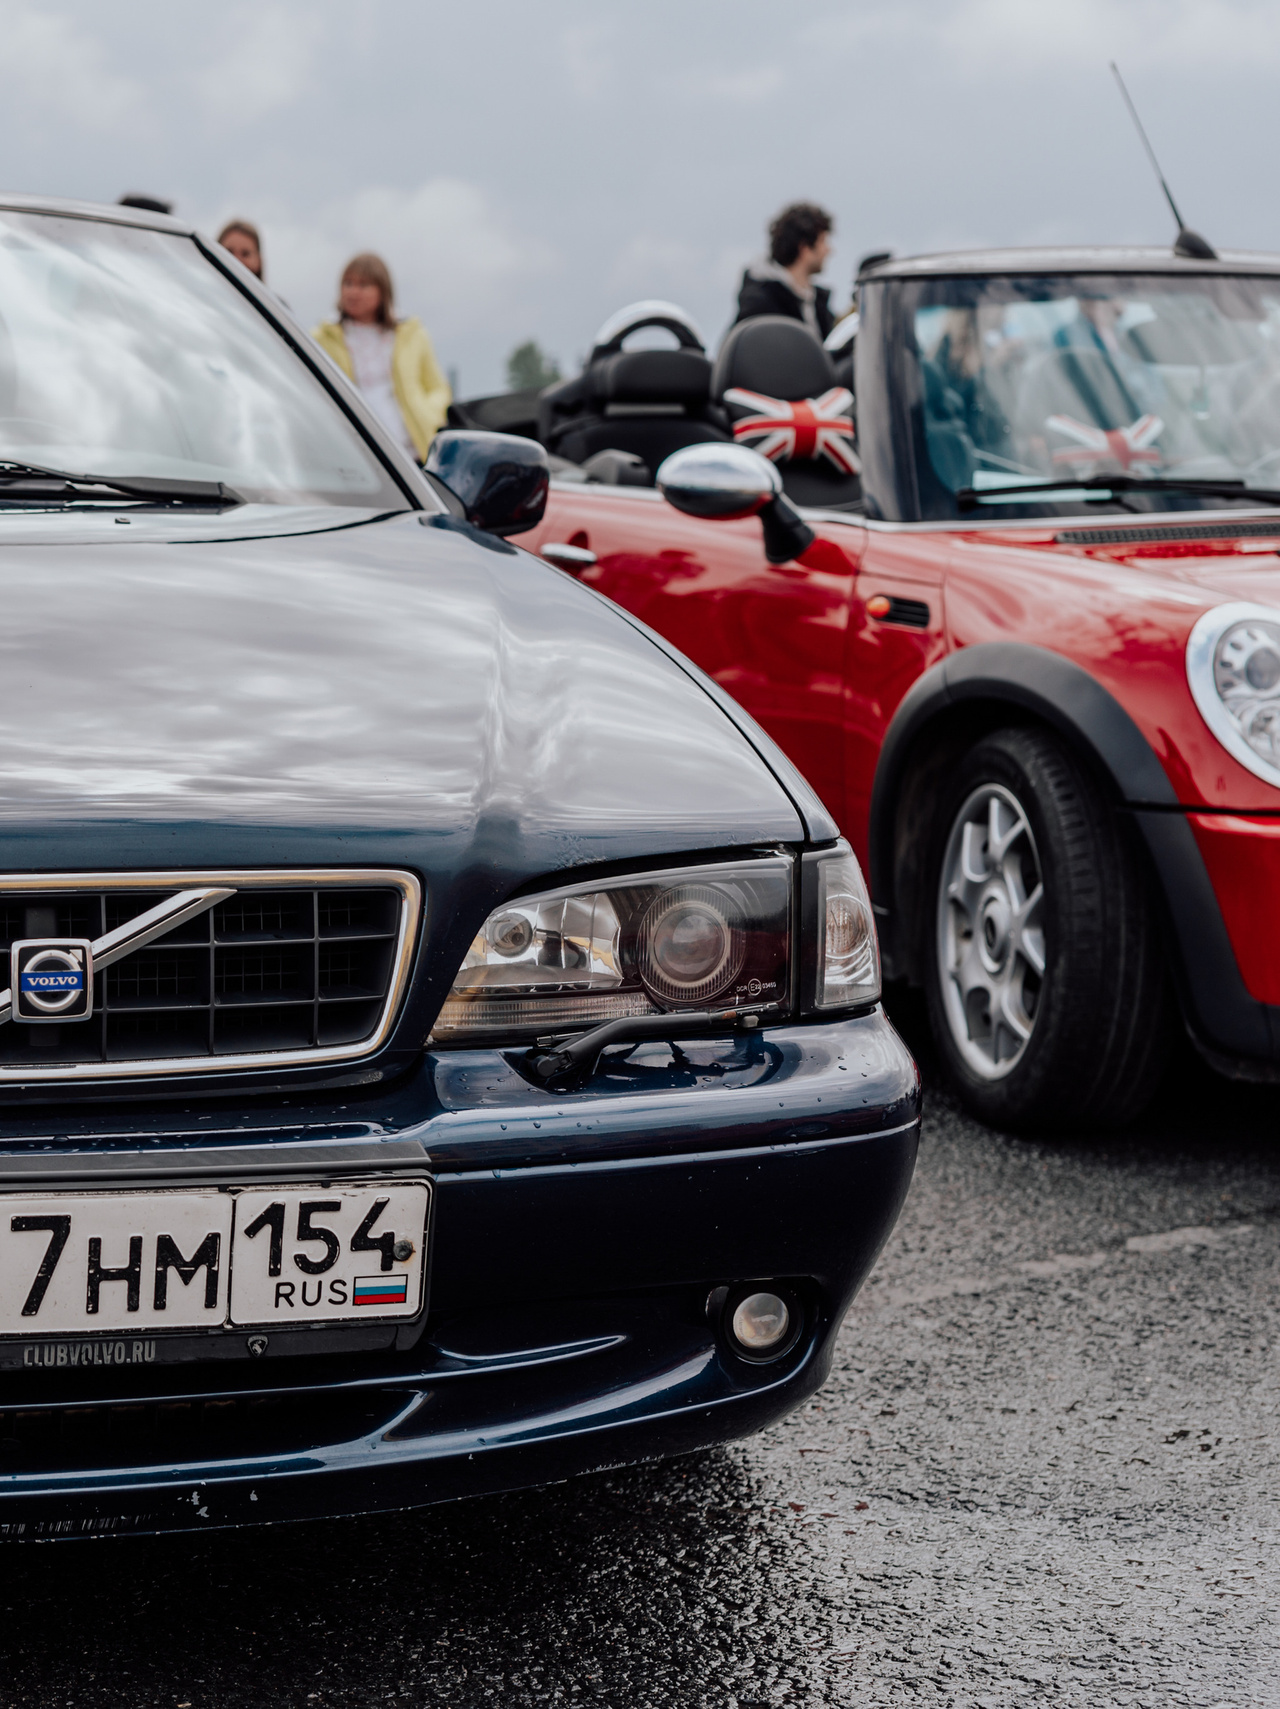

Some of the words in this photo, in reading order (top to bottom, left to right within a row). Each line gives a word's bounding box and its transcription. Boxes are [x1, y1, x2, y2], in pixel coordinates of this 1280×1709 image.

[27, 976, 78, 987] VOLVO
[243, 1196, 396, 1277] 154
[274, 1279, 348, 1308] RUS
[23, 1341, 156, 1367] CLUBVOLVO.RU
